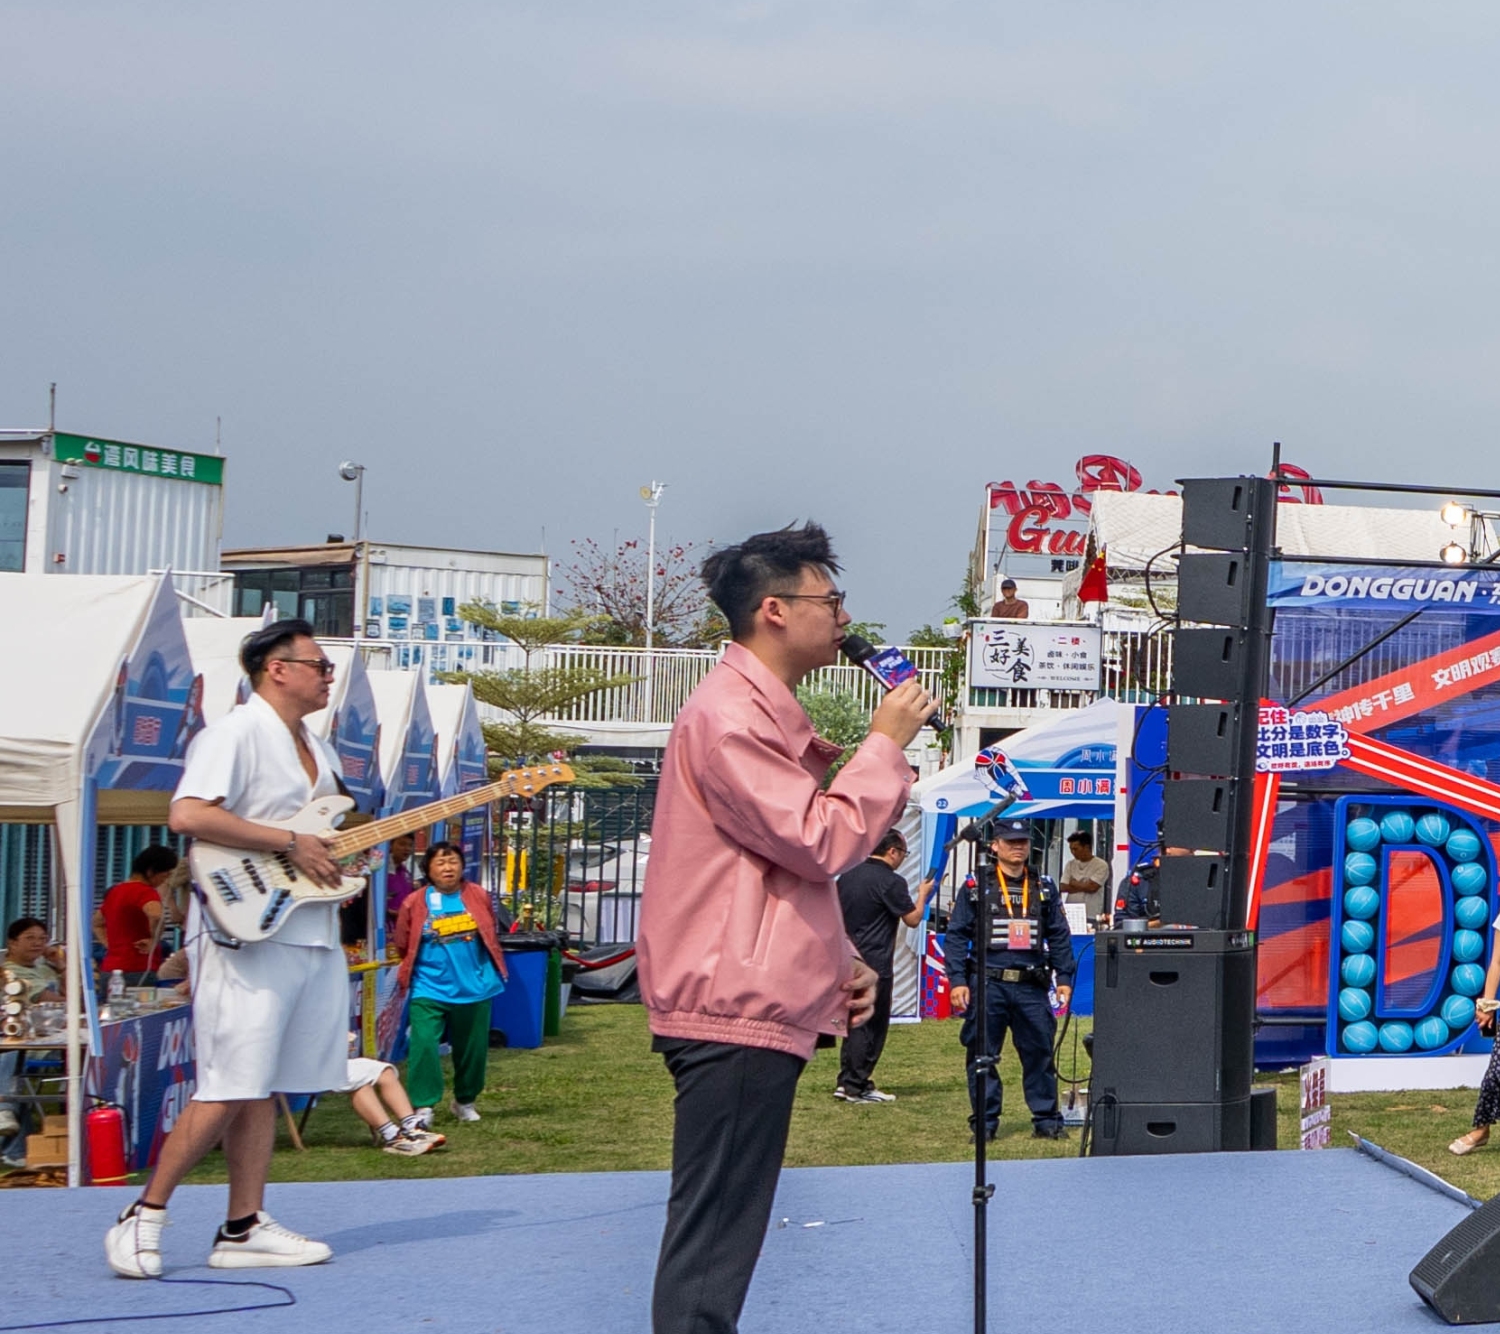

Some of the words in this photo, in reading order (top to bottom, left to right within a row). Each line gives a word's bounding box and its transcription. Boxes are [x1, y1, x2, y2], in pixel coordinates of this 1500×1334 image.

[1329, 683, 1415, 725] 神传千里
[1060, 778, 1116, 795] 周小满
